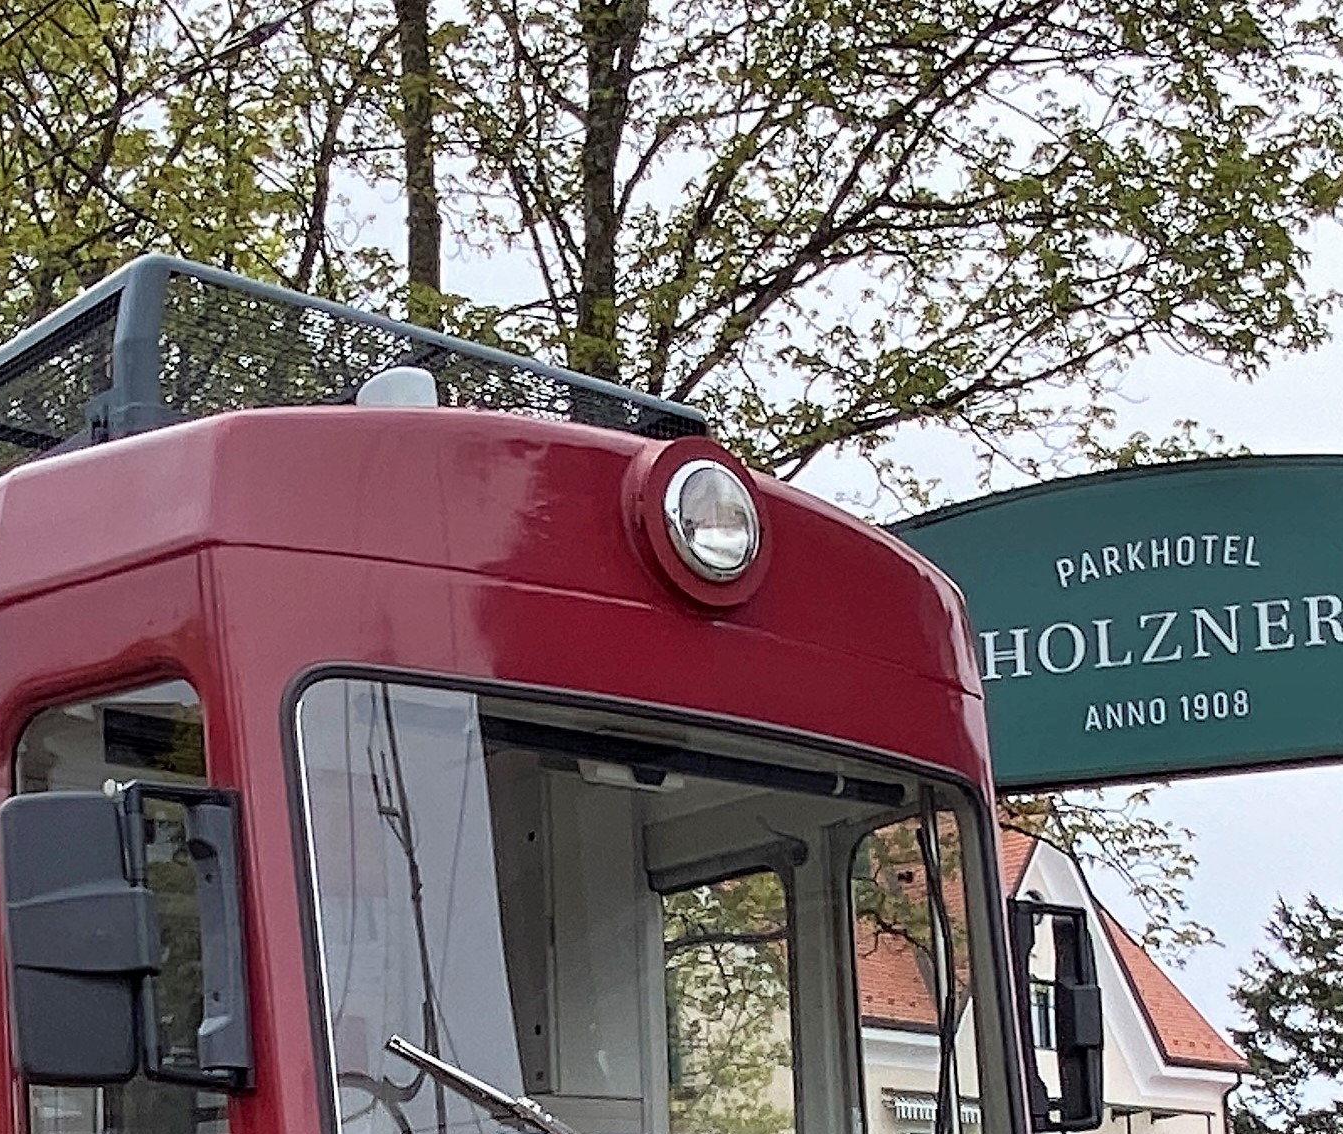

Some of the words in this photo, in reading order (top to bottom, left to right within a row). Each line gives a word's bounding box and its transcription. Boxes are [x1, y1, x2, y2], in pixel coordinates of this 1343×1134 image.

[1056, 534, 1261, 588] PARKHOTEL
[1084, 697, 1167, 732] ANNO
[1179, 689, 1251, 722] 1908
